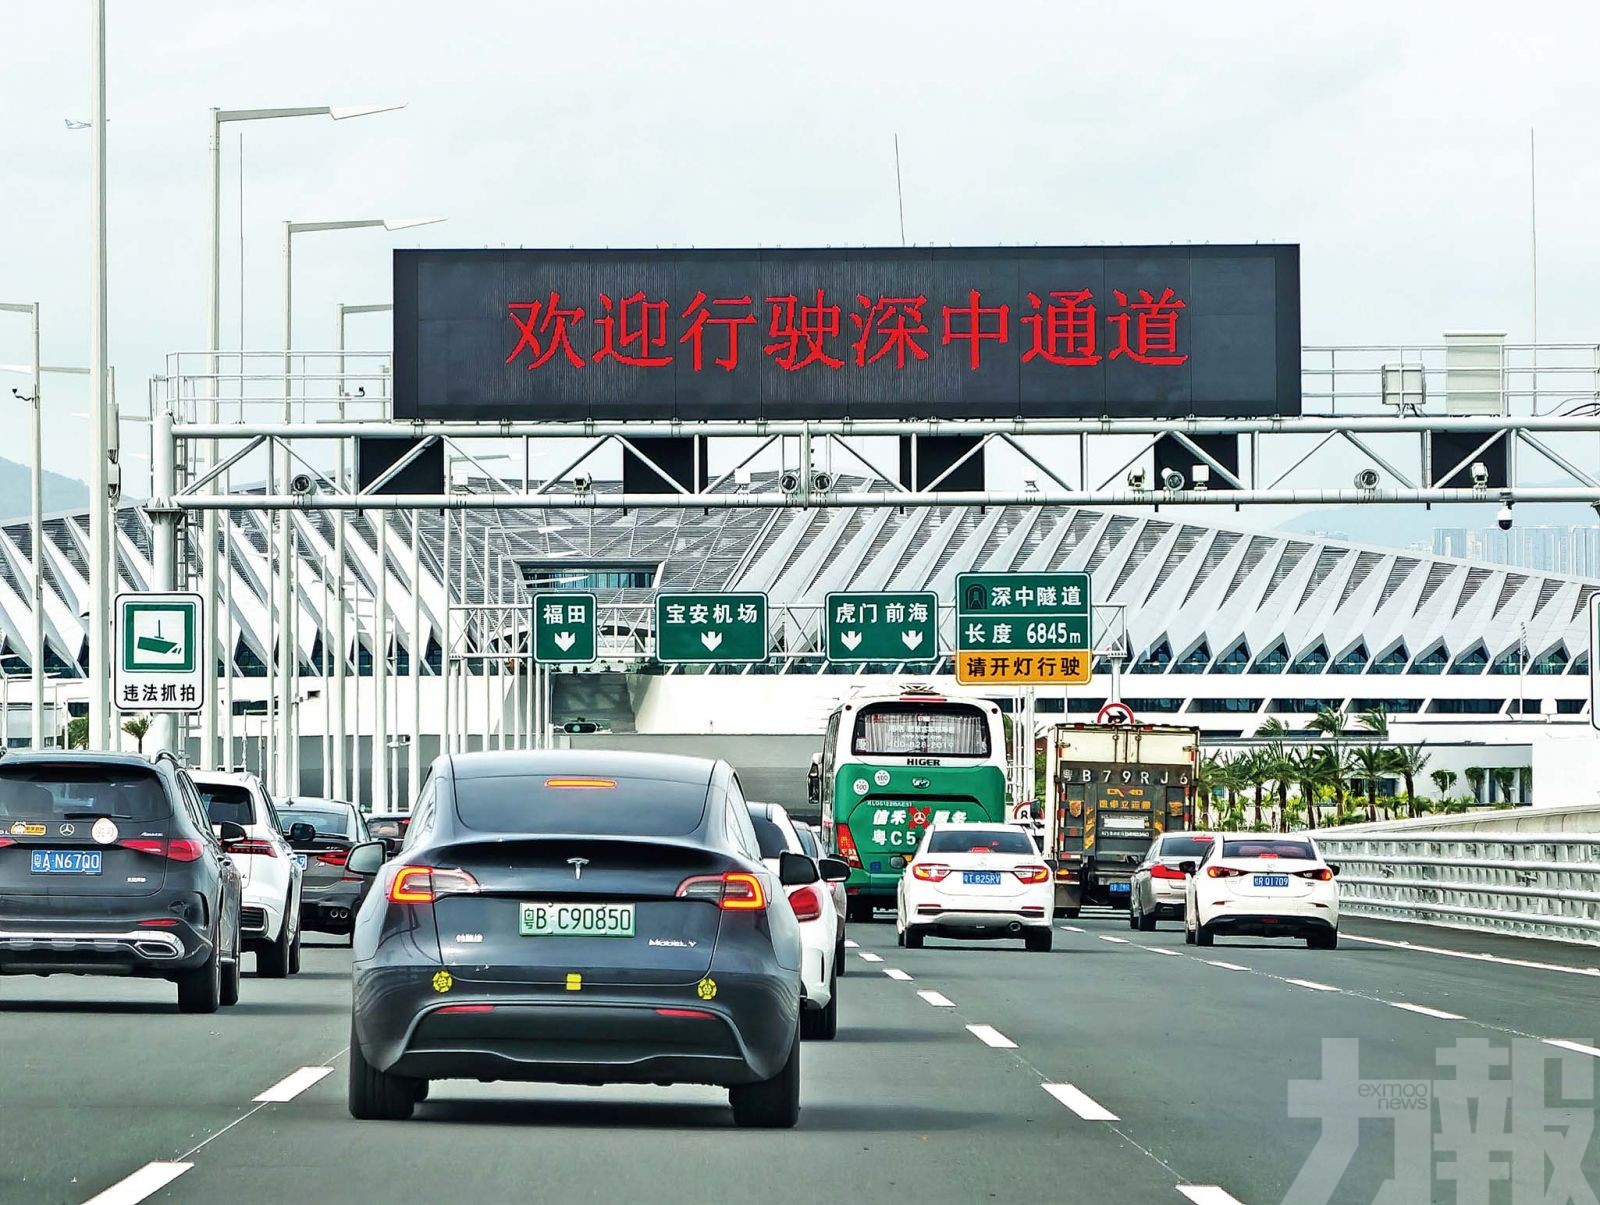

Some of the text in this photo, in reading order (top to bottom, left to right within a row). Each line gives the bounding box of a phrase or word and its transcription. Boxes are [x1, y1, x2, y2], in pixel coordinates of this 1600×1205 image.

[506, 288, 1189, 371] 欢迎行驶深中通道
[991, 585, 1082, 607] 深中隧道
[543, 603, 587, 625] 福田
[666, 602, 758, 625] 宝安机场
[835, 601, 929, 624] 虎门 前海
[964, 622, 1081, 644] 长度 6845m
[966, 656, 1081, 677] 请开灯行驶
[123, 683, 196, 702] 违法抓拍
[906, 758, 941, 766] HIGER
